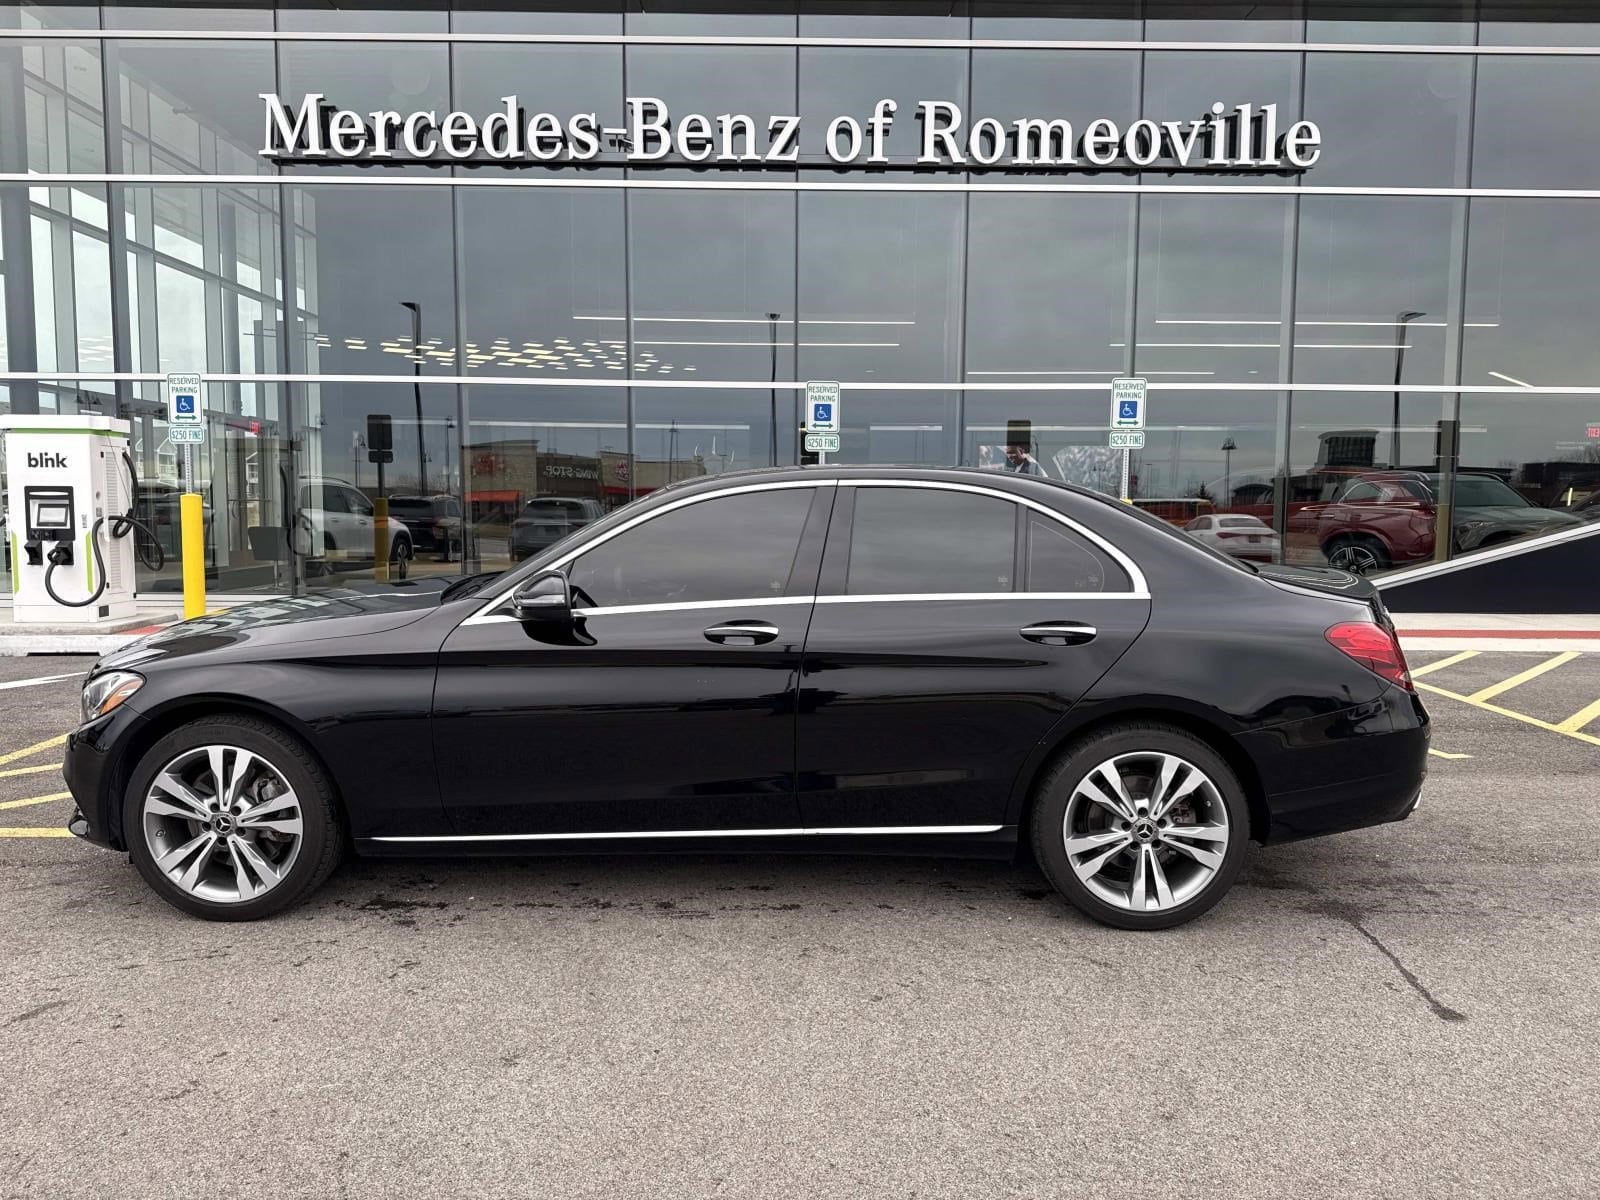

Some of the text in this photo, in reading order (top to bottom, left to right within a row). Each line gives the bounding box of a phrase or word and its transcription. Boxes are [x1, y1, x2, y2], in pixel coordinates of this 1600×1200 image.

[258, 93, 1321, 168] Mercedes-Benz of Romeoville
[169, 377, 199, 385] RESERVED
[171, 386, 198, 394] PARKING
[808, 385, 838, 394] RESERVED
[1114, 382, 1144, 391] RESERVED
[810, 394, 836, 402] PARKING
[1115, 391, 1142, 399] PARKING
[171, 430, 202, 440] $250 FINE
[807, 438, 838, 448] $250 FINE
[1111, 435, 1142, 445] $250 FINE
[27, 452, 68, 468] blink
